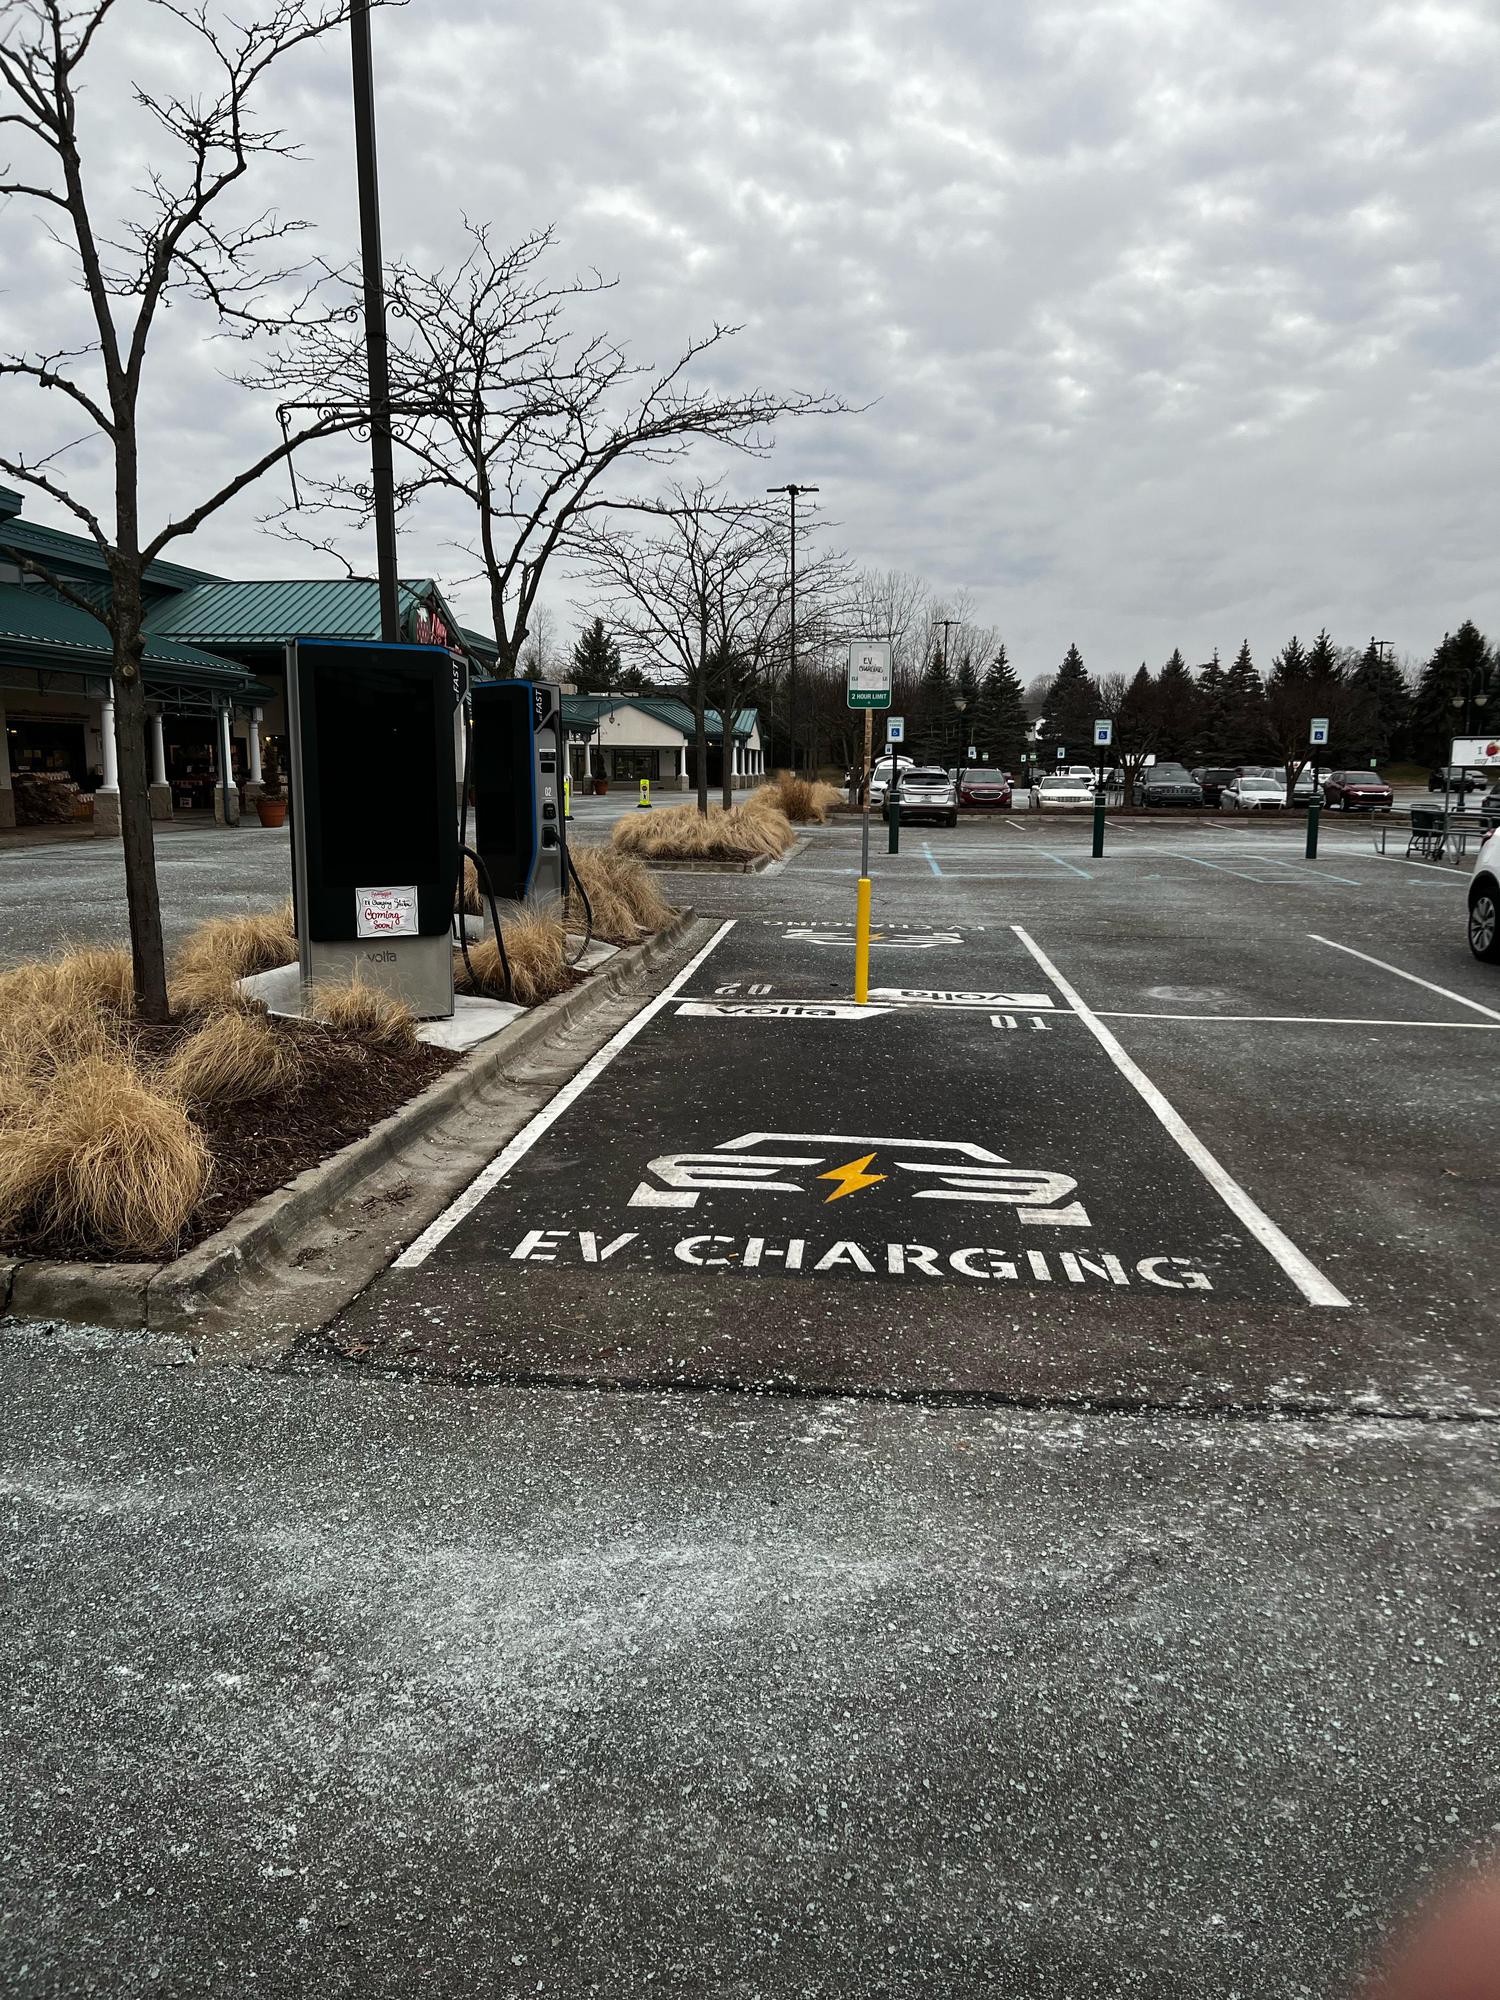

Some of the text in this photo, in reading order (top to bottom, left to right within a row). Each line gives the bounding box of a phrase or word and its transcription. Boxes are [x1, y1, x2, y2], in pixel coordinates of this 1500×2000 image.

[863, 657, 872, 665] EV
[545, 786, 552, 797] 02
[365, 907, 404, 925] Coming
[373, 920, 394, 930] Soon!
[367, 950, 397, 963] volta
[714, 1006, 837, 1017] volta
[988, 1015, 1053, 1030] 01
[508, 1230, 1215, 1290] EV CHARGING
